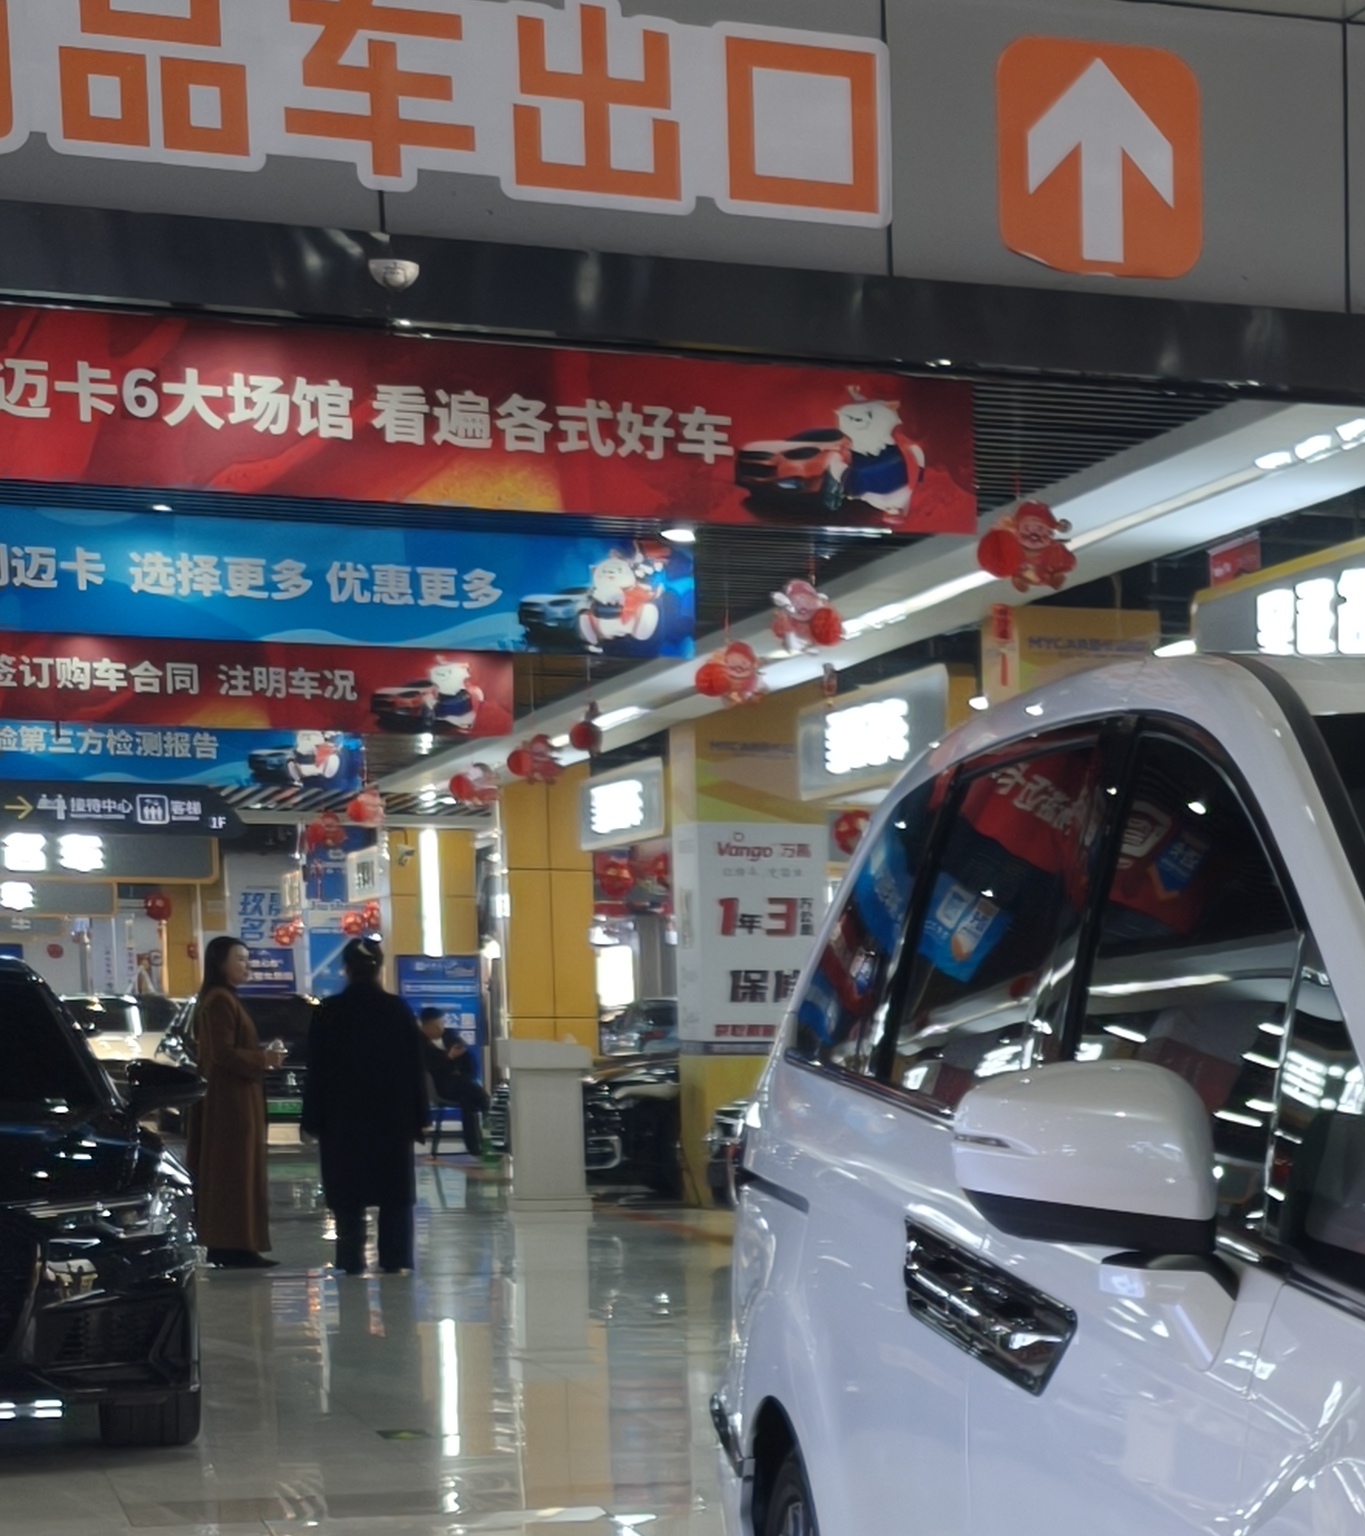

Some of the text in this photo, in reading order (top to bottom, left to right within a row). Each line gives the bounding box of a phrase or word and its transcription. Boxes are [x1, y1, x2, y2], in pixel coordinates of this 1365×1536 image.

[0, 0, 880, 214] 品车出口
[0, 357, 734, 464] 迈卡6大场馆 看遍各式好车
[0, 544, 503, 609] 迈卡 选择更多 优惠更多
[217, 664, 358, 701] 注明车况
